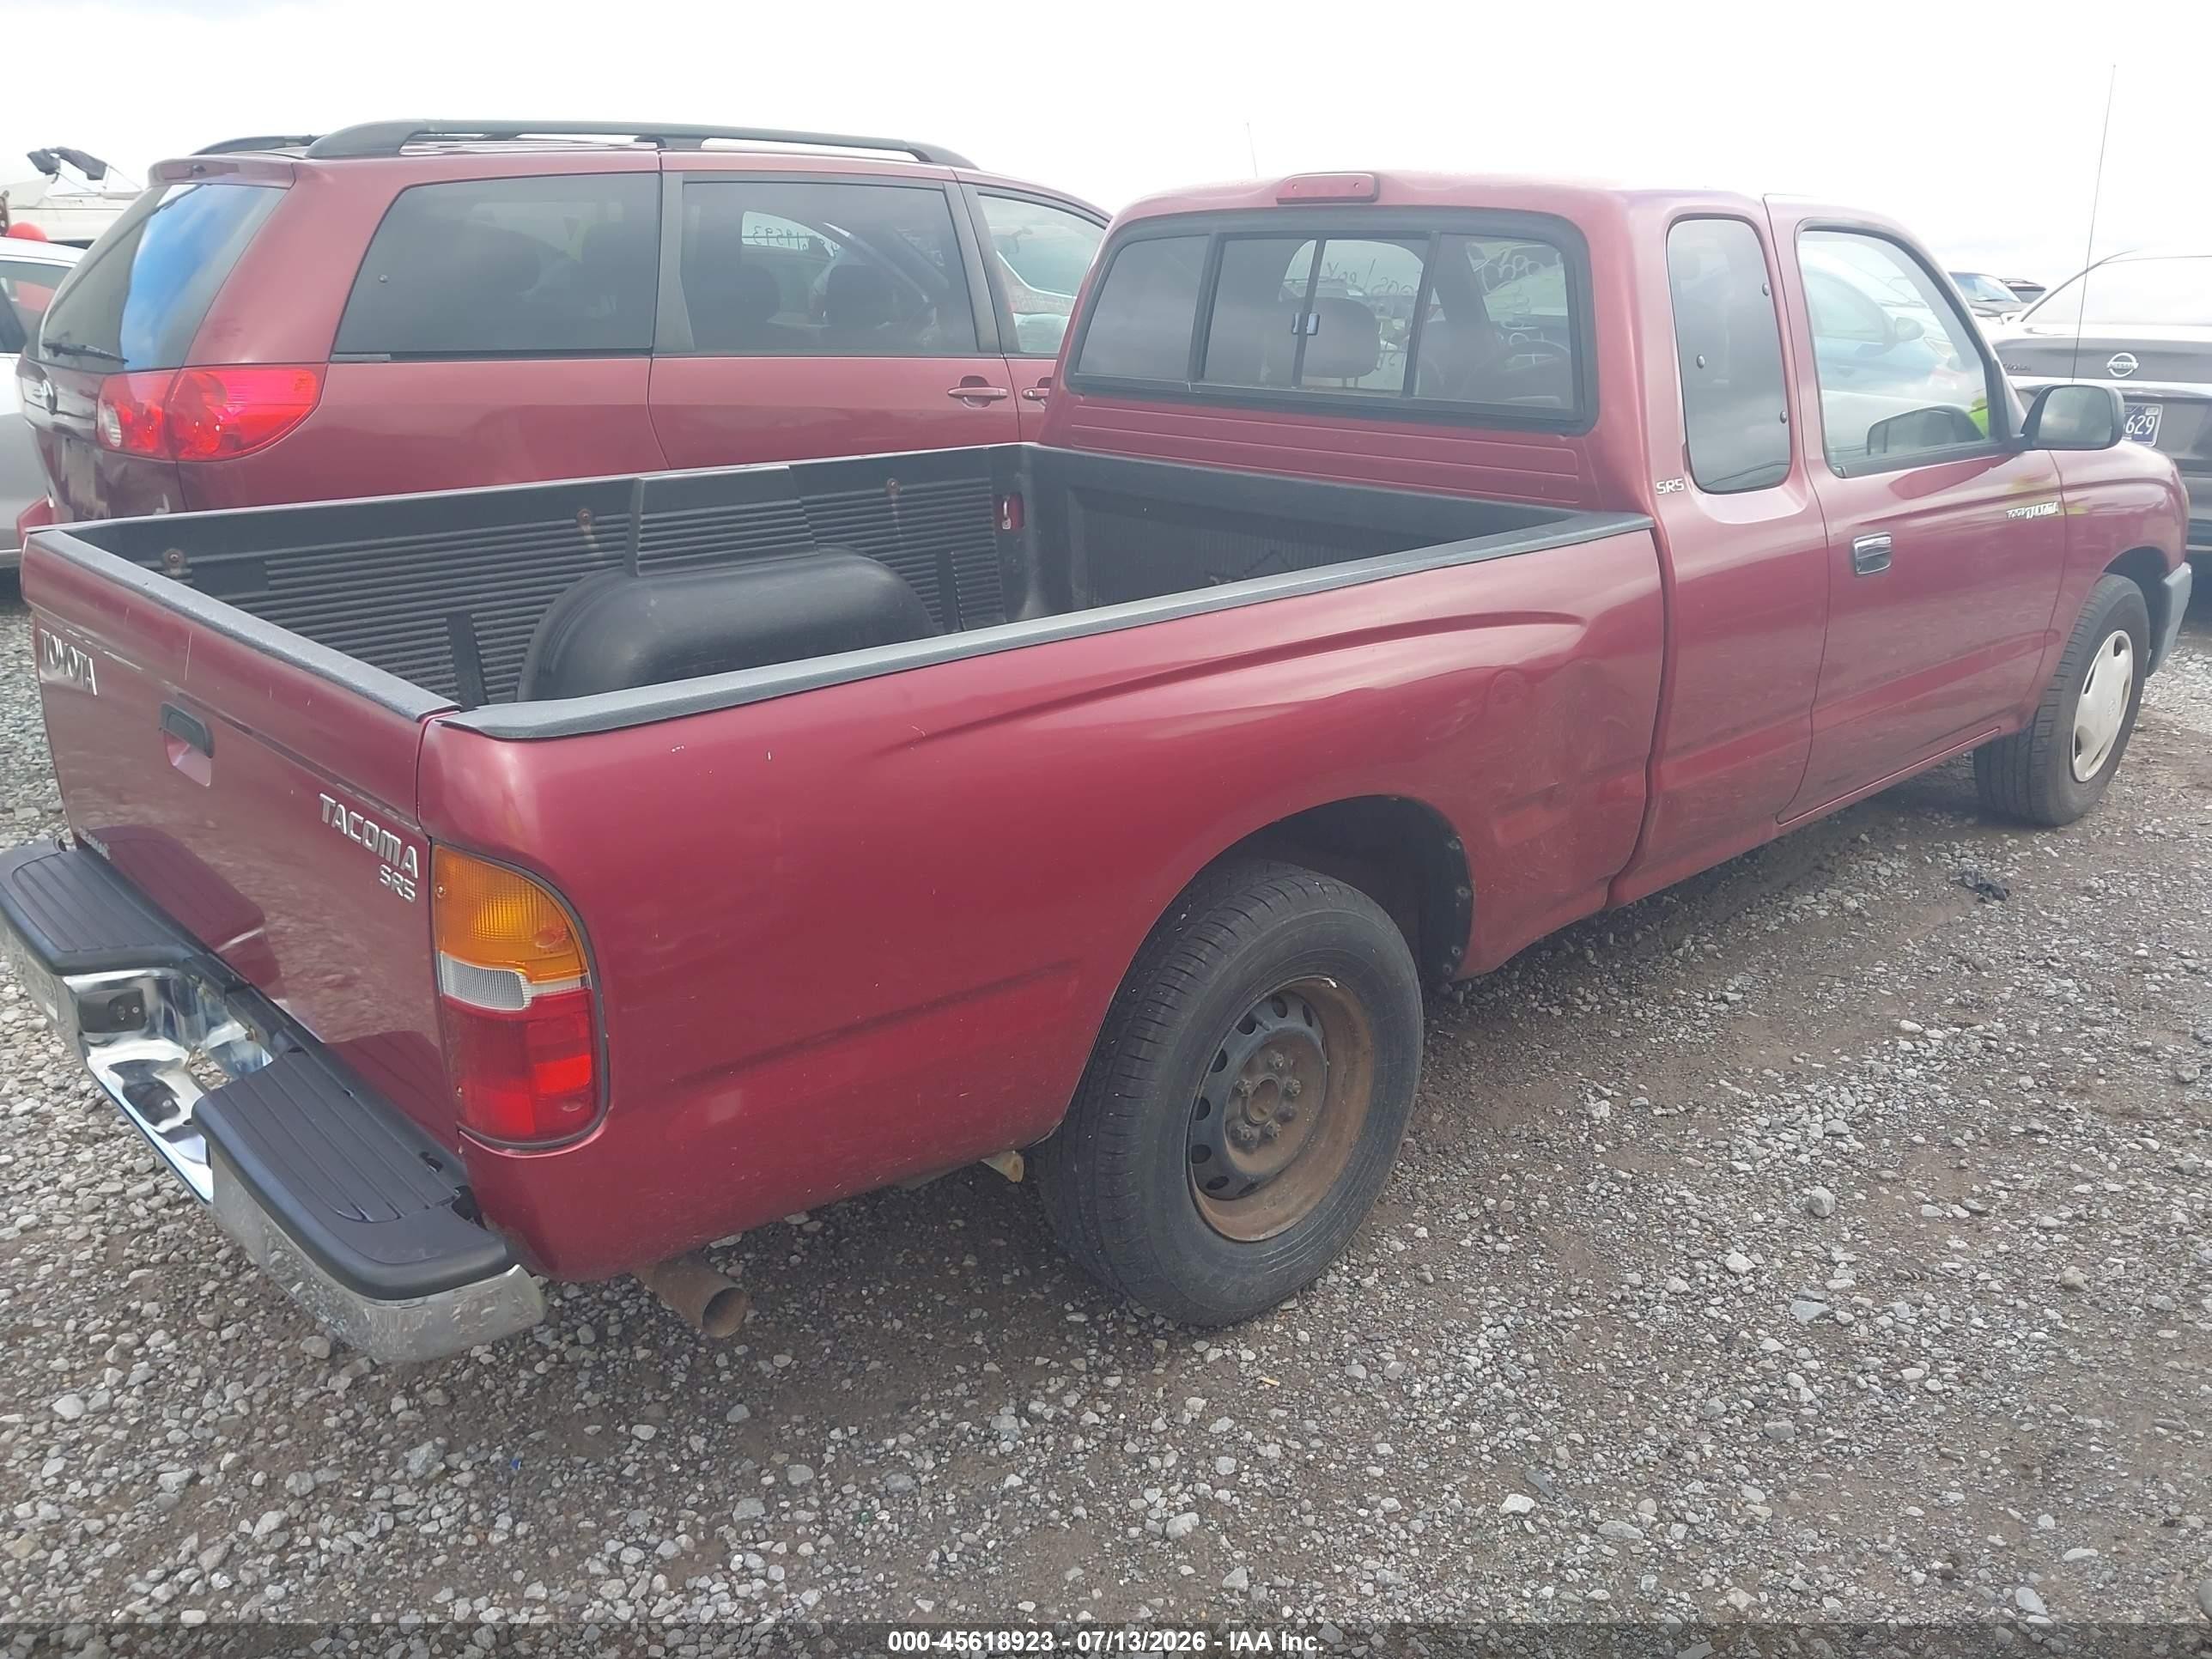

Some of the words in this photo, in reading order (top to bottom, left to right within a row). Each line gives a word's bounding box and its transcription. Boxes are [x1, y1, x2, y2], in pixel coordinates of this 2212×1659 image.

[2123, 415, 2155, 435] 629
[39, 627, 98, 696] TOYOTA
[319, 792, 419, 879] TACOMA
